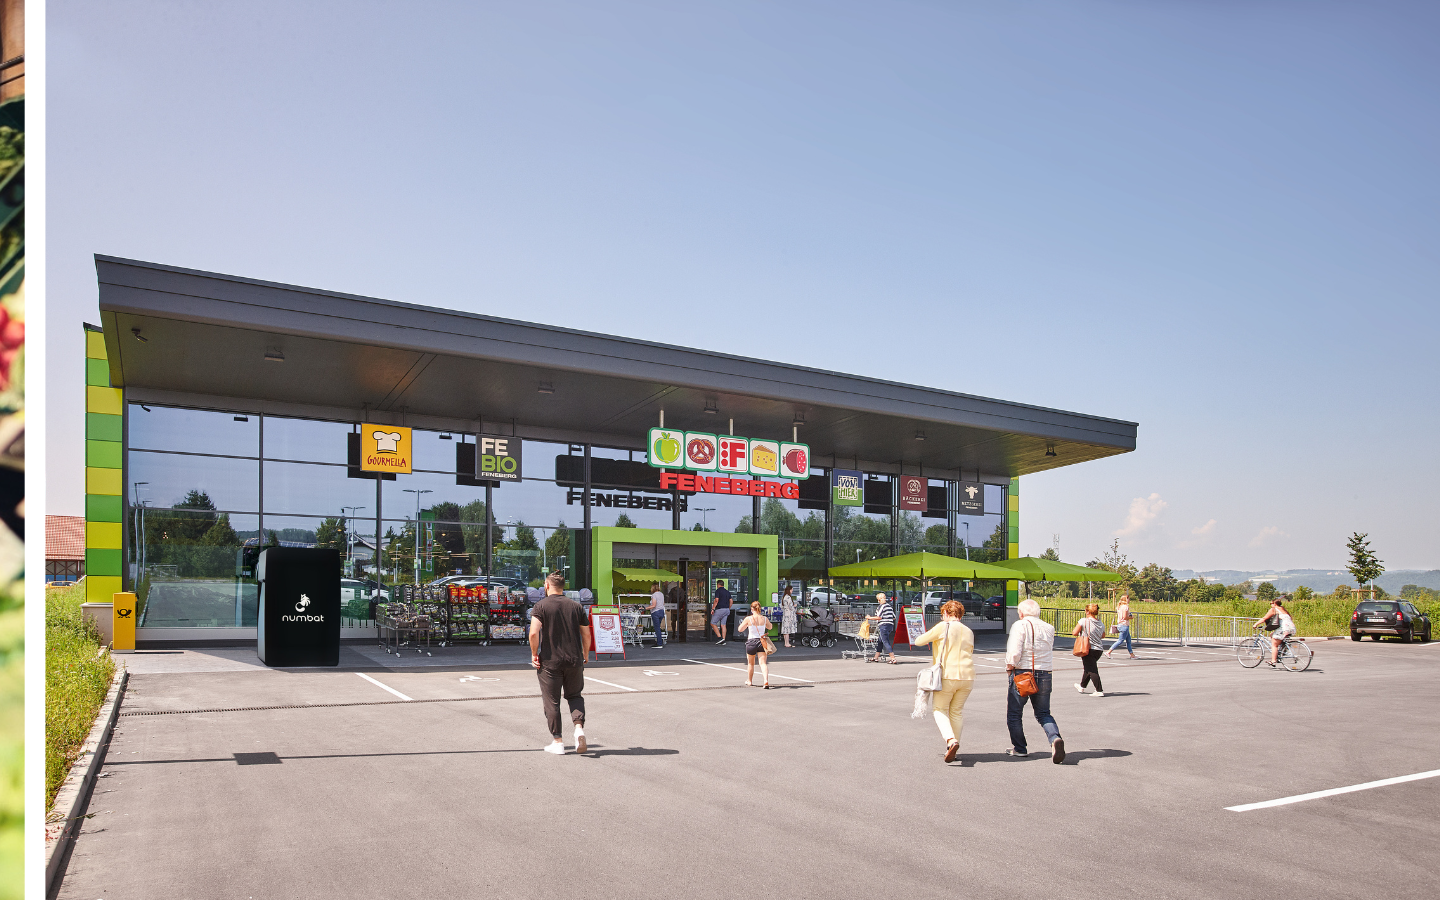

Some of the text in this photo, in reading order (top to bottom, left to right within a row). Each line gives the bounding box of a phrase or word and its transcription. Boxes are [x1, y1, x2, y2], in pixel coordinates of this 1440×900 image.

[481, 437, 508, 456] FE
[367, 455, 407, 468] GOURMELLA
[481, 455, 518, 473] BIO
[659, 472, 800, 499] FENEBERG
[840, 478, 857, 488] VON
[840, 487, 857, 498] HIER
[282, 614, 325, 622] numbat
